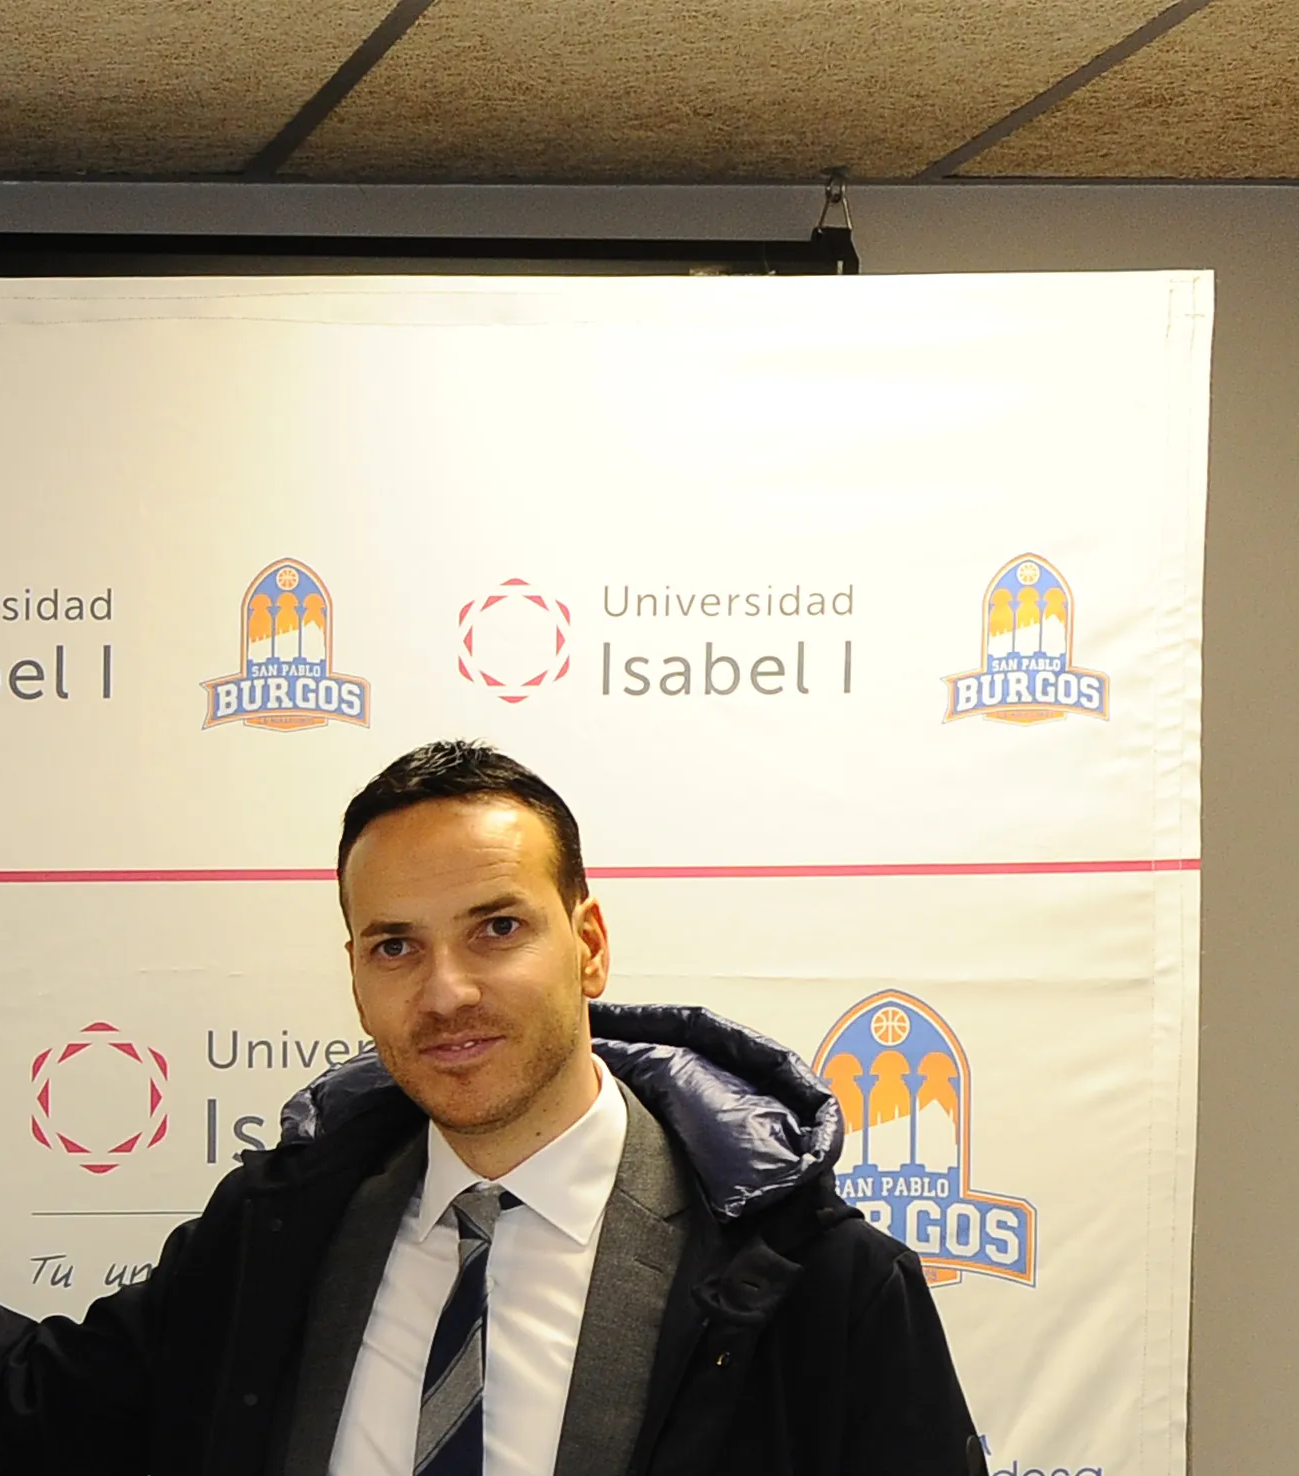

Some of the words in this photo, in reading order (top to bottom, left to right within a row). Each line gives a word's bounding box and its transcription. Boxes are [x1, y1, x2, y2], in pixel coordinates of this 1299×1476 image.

[603, 585, 854, 618] Universidad
[104, 644, 112, 699] I
[252, 664, 278, 677] SAN
[282, 664, 321, 678] PABLO
[603, 640, 809, 697] Isabel
[844, 640, 853, 695] I
[992, 658, 1018, 672] SAN
[1021, 658, 1061, 672] PABLO
[216, 677, 361, 717] BURGOS
[956, 671, 1100, 712] BURGOS
[881, 1176, 949, 1198] PABLO
[856, 1200, 1019, 1265] RGOS
[30, 1254, 74, 1289] Tu
